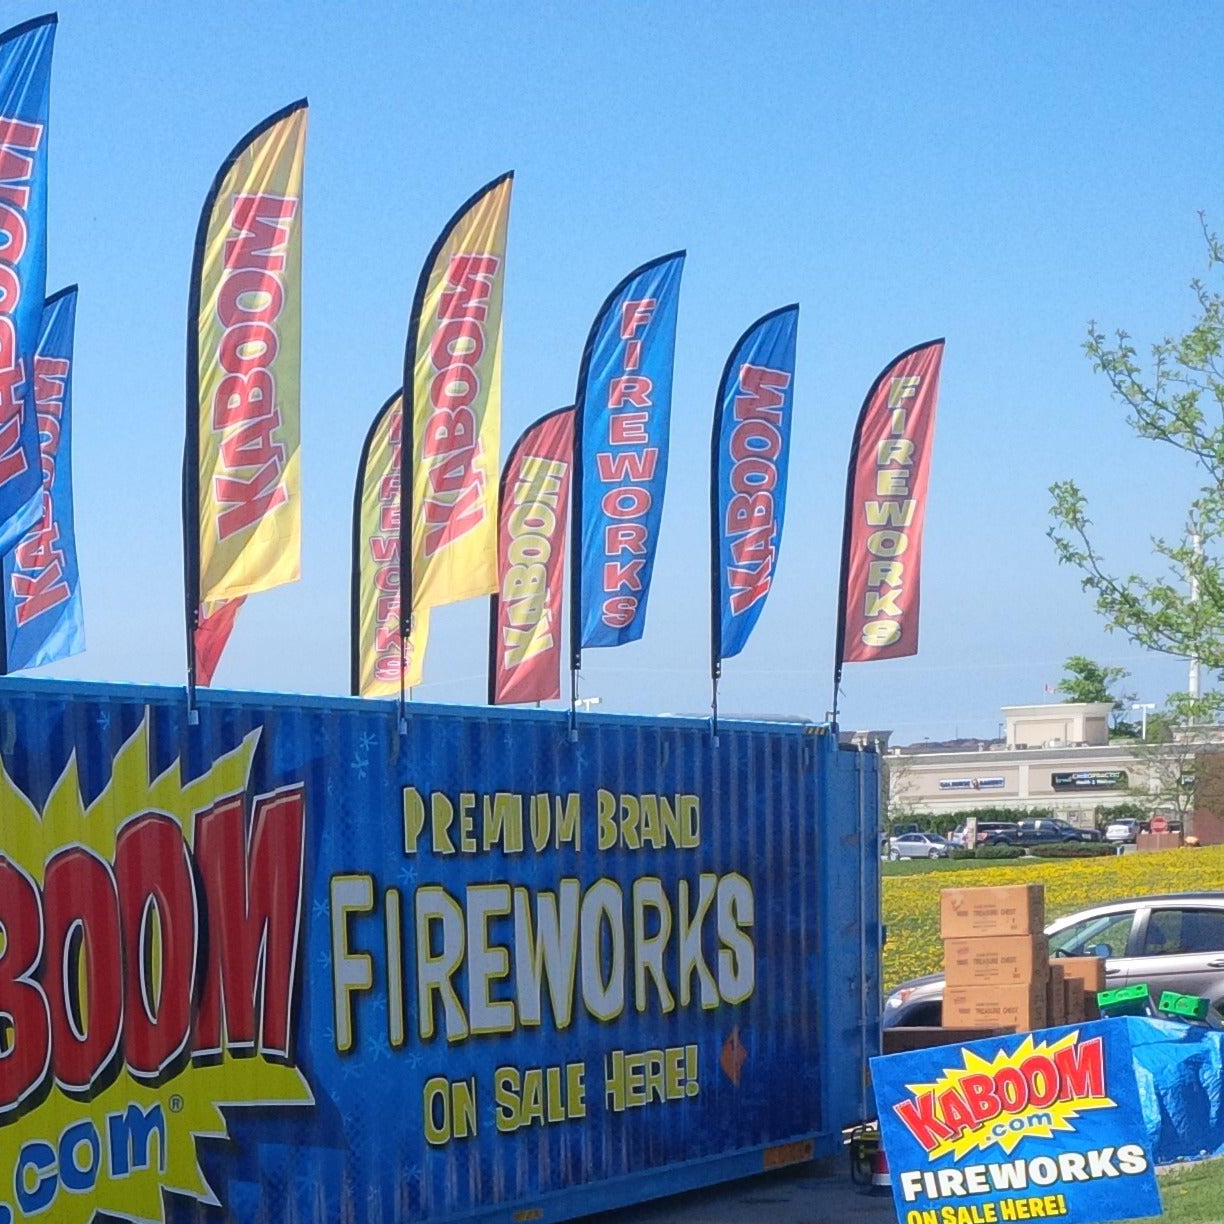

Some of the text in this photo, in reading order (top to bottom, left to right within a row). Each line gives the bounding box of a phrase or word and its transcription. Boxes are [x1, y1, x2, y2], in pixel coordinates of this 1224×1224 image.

[212, 193, 299, 540] KABOOM
[422, 253, 500, 558] KABOOM
[597, 298, 658, 629] FIREWORKS
[503, 456, 567, 670] KABOOM
[726, 364, 791, 616] KABOOM
[862, 376, 917, 647] FIREWORKS
[403, 786, 700, 854] PREMIUM BRAND
[329, 871, 756, 1052] FIREWORKS
[424, 1044, 700, 1145] ON SALE HERE!
[893, 1036, 1106, 1152] KABOOM
[900, 1144, 1148, 1203] FIREWORKS
[999, 1195, 1067, 1223] HERE!
